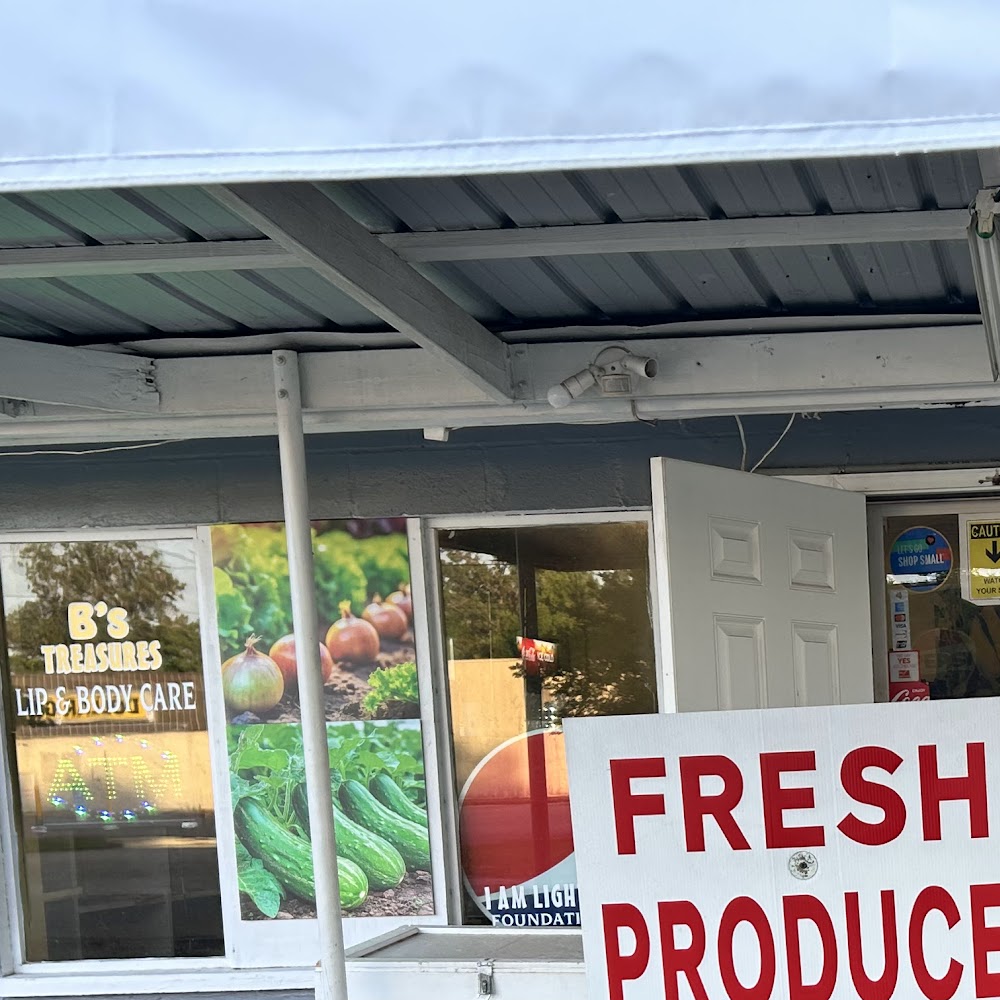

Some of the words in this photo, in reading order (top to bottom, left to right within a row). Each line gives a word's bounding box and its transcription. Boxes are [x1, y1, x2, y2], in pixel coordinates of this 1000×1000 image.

[898, 555, 918, 567] SHOP
[920, 552, 945, 565] SMALL
[976, 587, 997, 595] YOUR
[67, 601, 130, 641] B's
[40, 639, 163, 675] TREASURES
[15, 687, 48, 717] LIP
[56, 686, 71, 716] &
[76, 683, 133, 714] BODY
[140, 681, 197, 712] CARE
[47, 751, 182, 801] ATM
[609, 742, 990, 856] FRESH
[484, 886, 492, 910] I
[498, 885, 528, 910] AM
